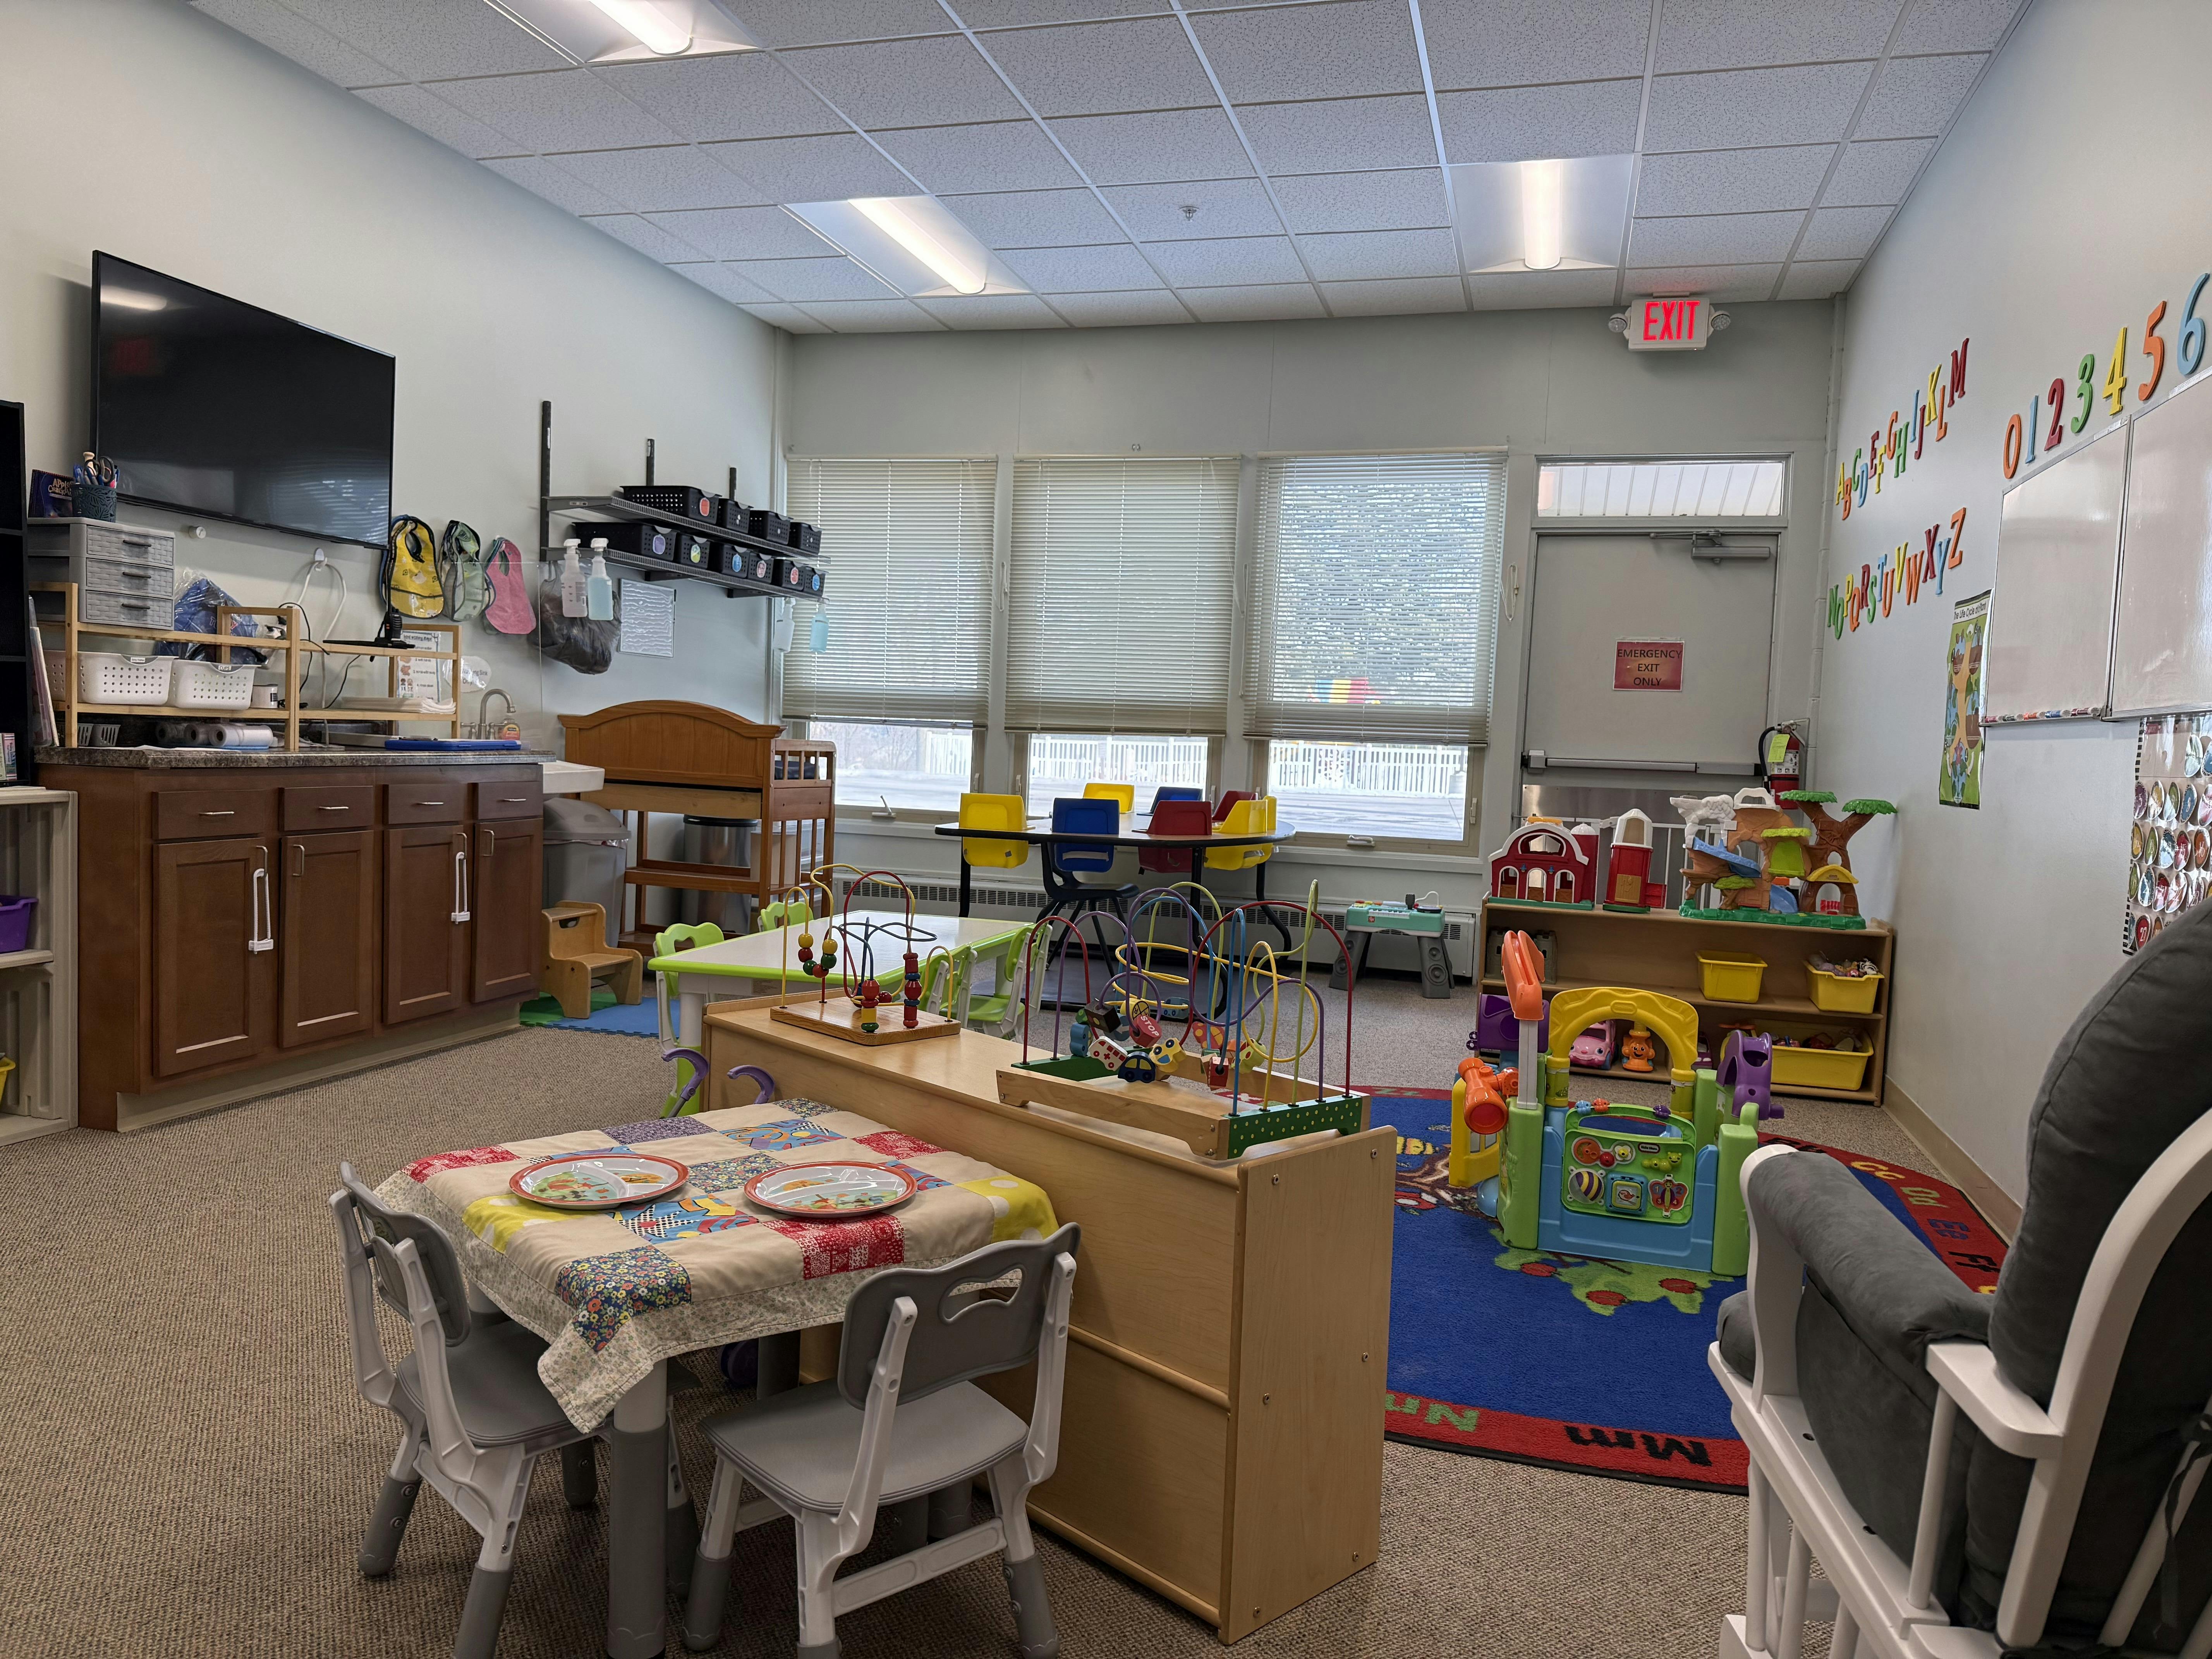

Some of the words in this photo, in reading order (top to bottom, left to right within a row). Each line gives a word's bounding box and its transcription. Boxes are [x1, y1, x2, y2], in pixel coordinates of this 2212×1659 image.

[1643, 301, 1700, 341] EXIT
[2003, 414, 2021, 479] 0
[2025, 395, 2039, 464] 1
[2044, 378, 2064, 451] 2
[2071, 354, 2094, 433] 3
[2102, 327, 2127, 416] 4
[2138, 301, 2167, 401] 5
[2177, 273, 2210, 375] 6
[1966, 607, 1975, 618] Cycle
[1618, 649, 1682, 658] EMERGENCY
[1638, 663, 1660, 672] EXIT
[1634, 677, 1662, 686] ONLY
[2140, 927, 2147, 942] 27
[1140, 1015, 1159, 1036] STOP
[1564, 1425, 1712, 1466] Mm
